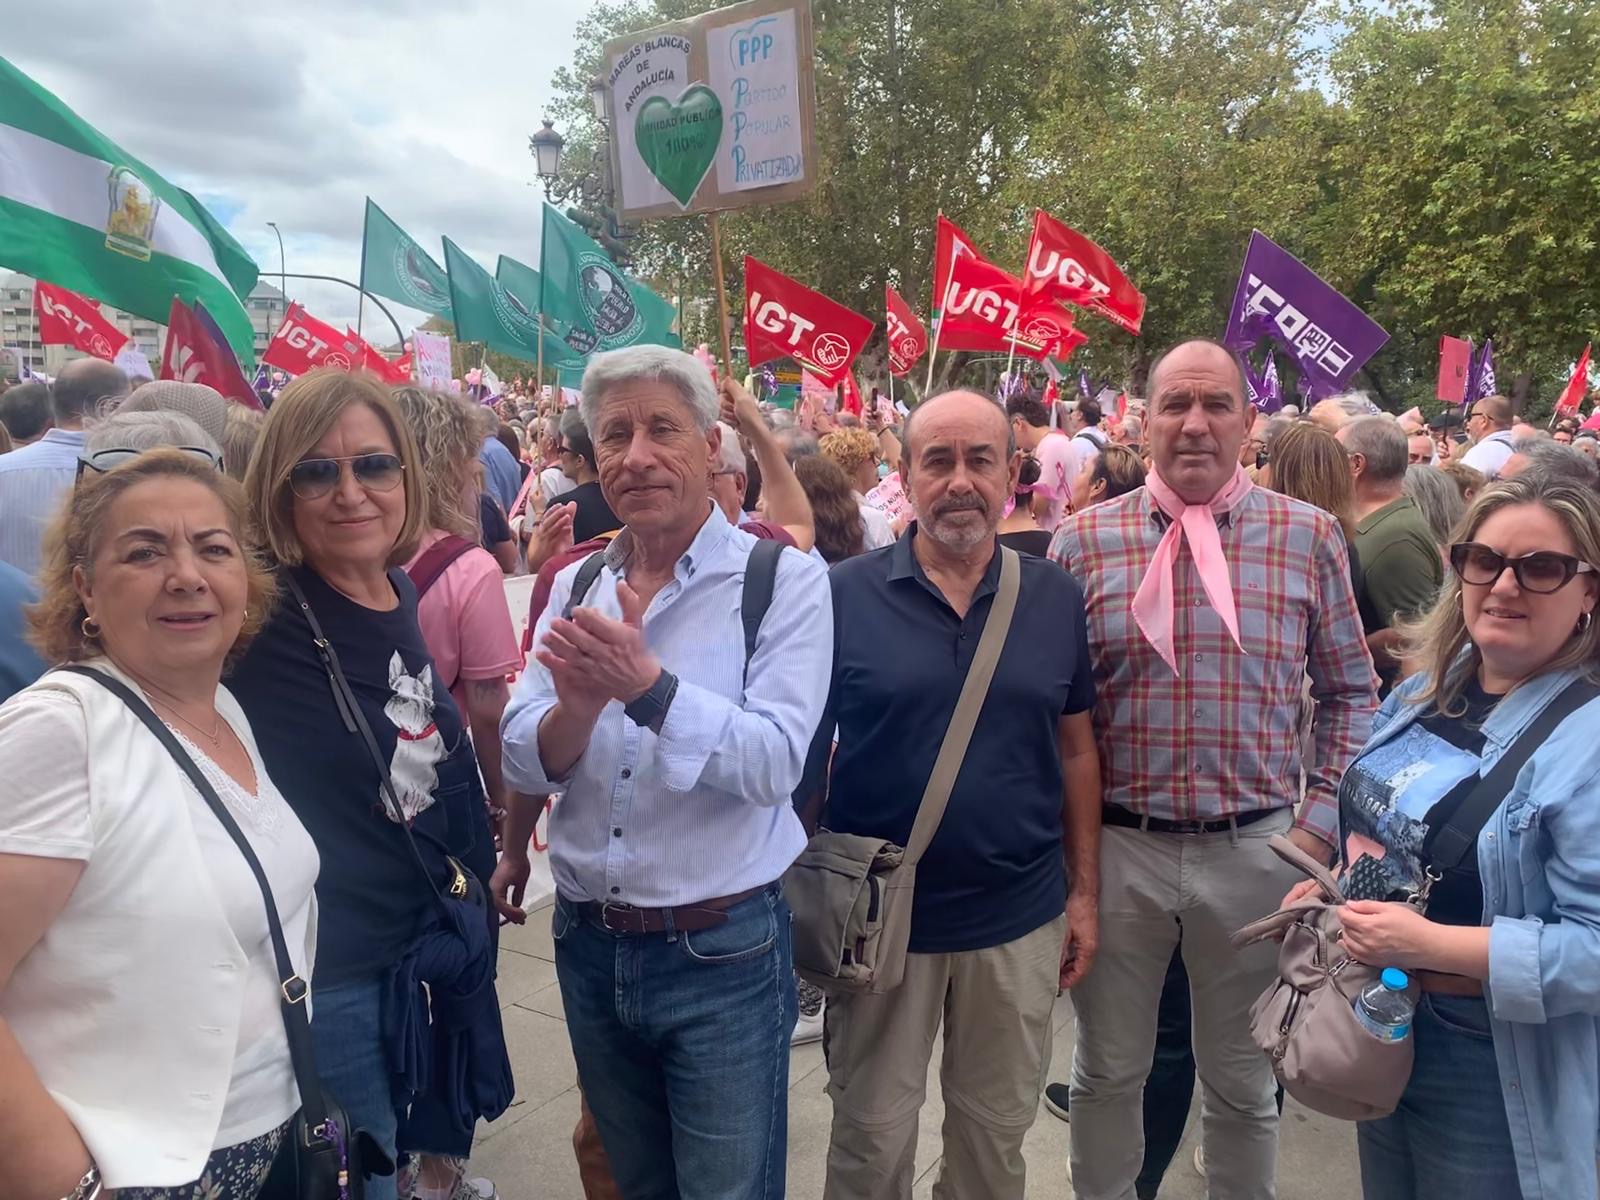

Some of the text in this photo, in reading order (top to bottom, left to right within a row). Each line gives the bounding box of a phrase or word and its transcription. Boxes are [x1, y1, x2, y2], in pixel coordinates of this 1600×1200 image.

[609, 36, 690, 87] MAREAS BLANCAS
[636, 60, 650, 73] DE
[739, 34, 773, 66] PPP
[625, 68, 674, 112] ANDALUCÍA
[1029, 239, 1110, 295] UGT
[946, 281, 1019, 329] UGT
